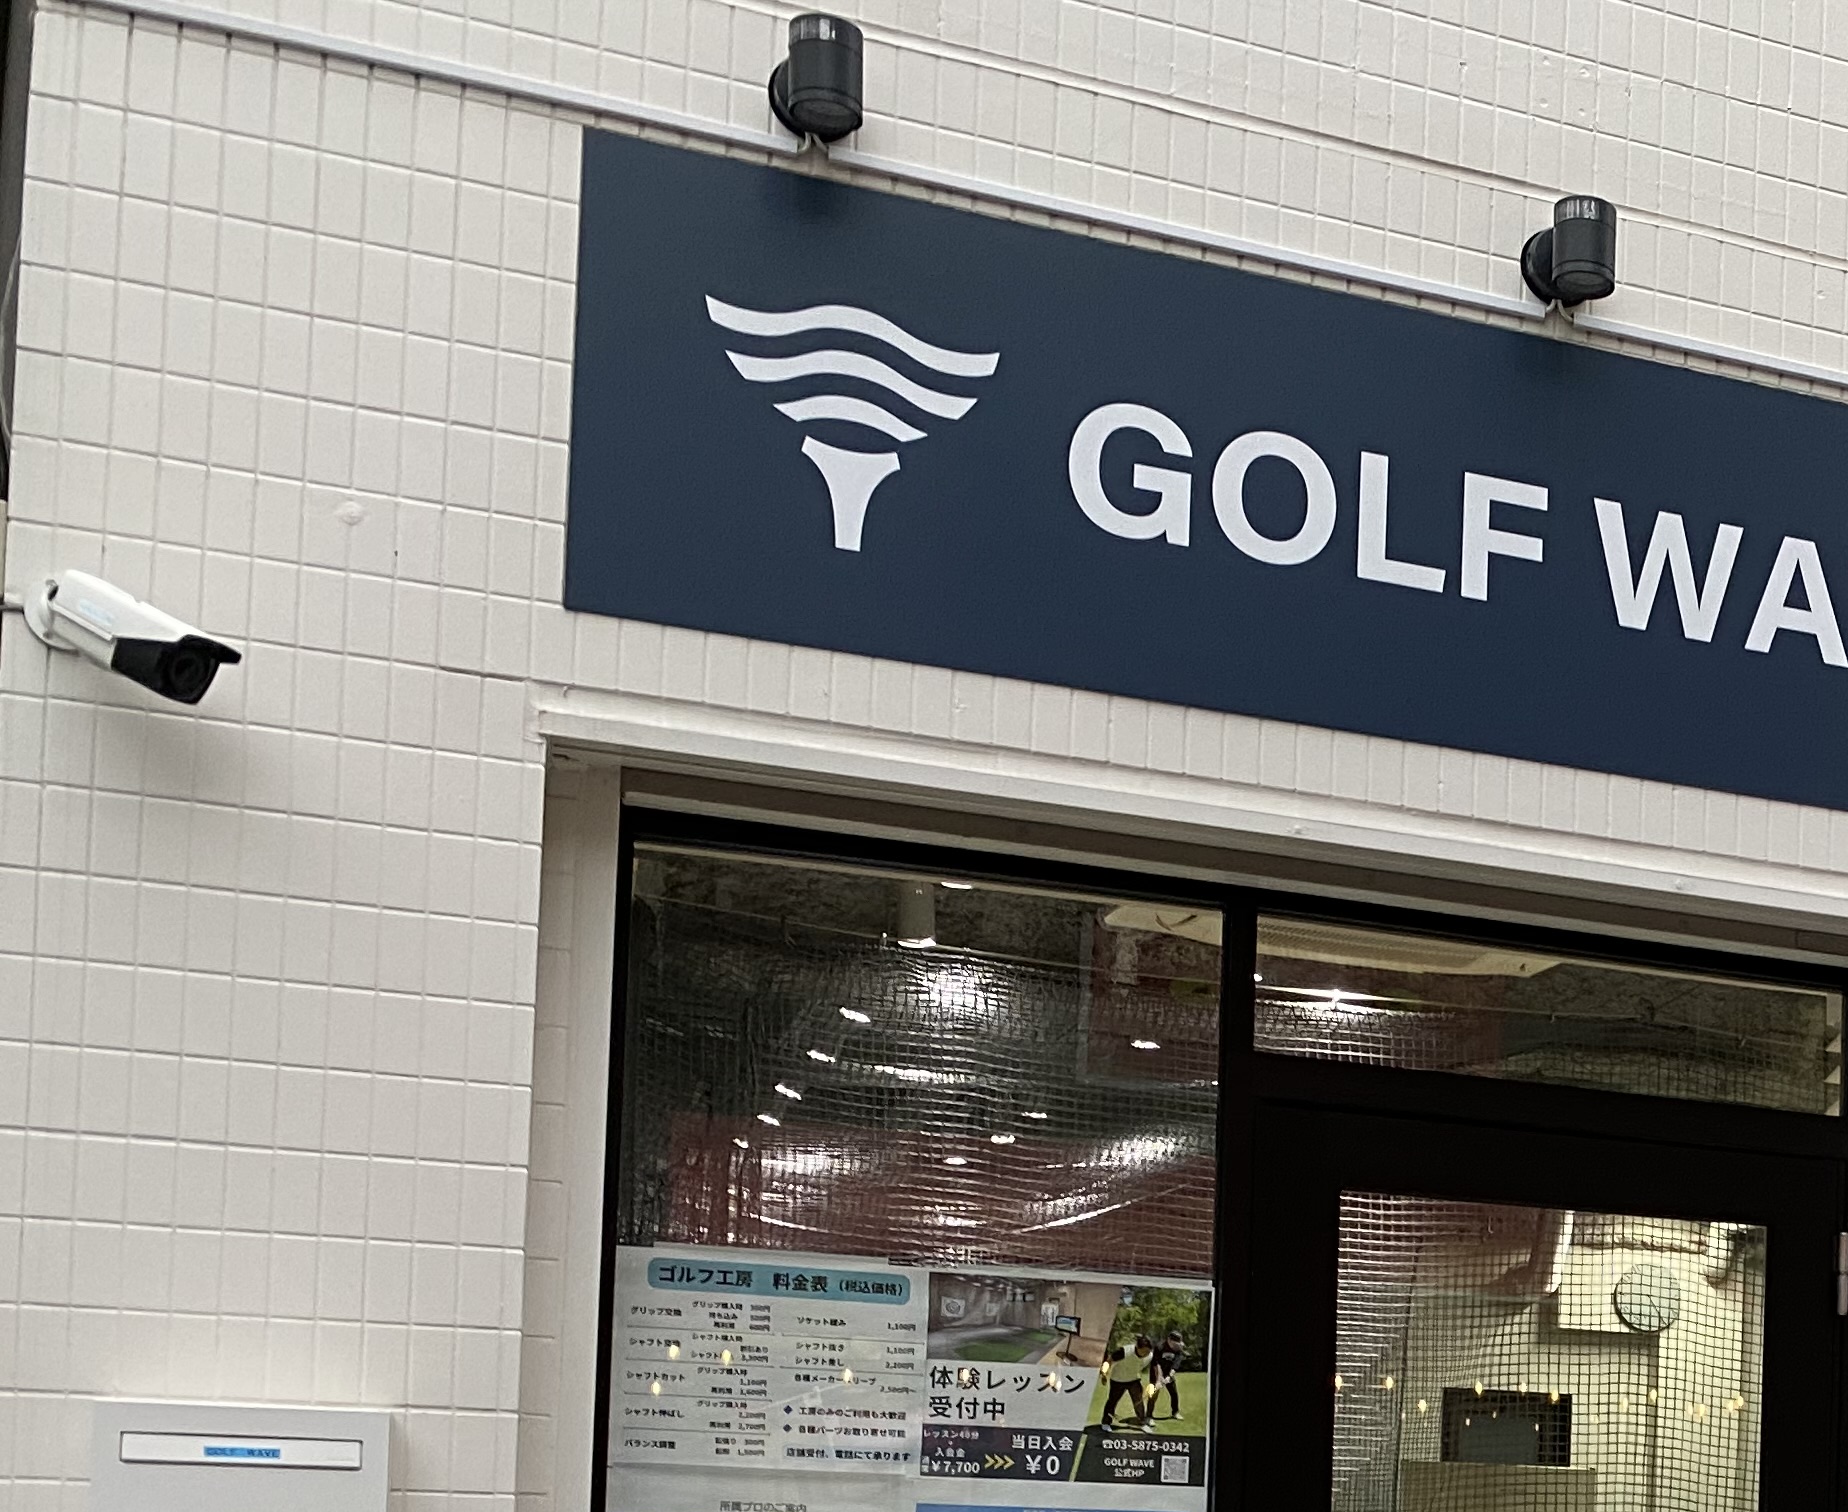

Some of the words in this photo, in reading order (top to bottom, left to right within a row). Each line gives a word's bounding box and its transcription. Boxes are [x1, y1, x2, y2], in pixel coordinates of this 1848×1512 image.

[1068, 402, 1550, 601] GOLF
[658, 1265, 753, 1287] ゴルフ工房
[772, 1272, 828, 1293] 料金表
[626, 1370, 685, 1382] シャフトカット
[929, 1365, 1085, 1395] 体験レッスン
[928, 1396, 1006, 1422] 受付中
[1011, 1434, 1074, 1452] 当日入会
[1103, 1457, 1128, 1467] GOLF
[1129, 1458, 1155, 1468] WAVE
